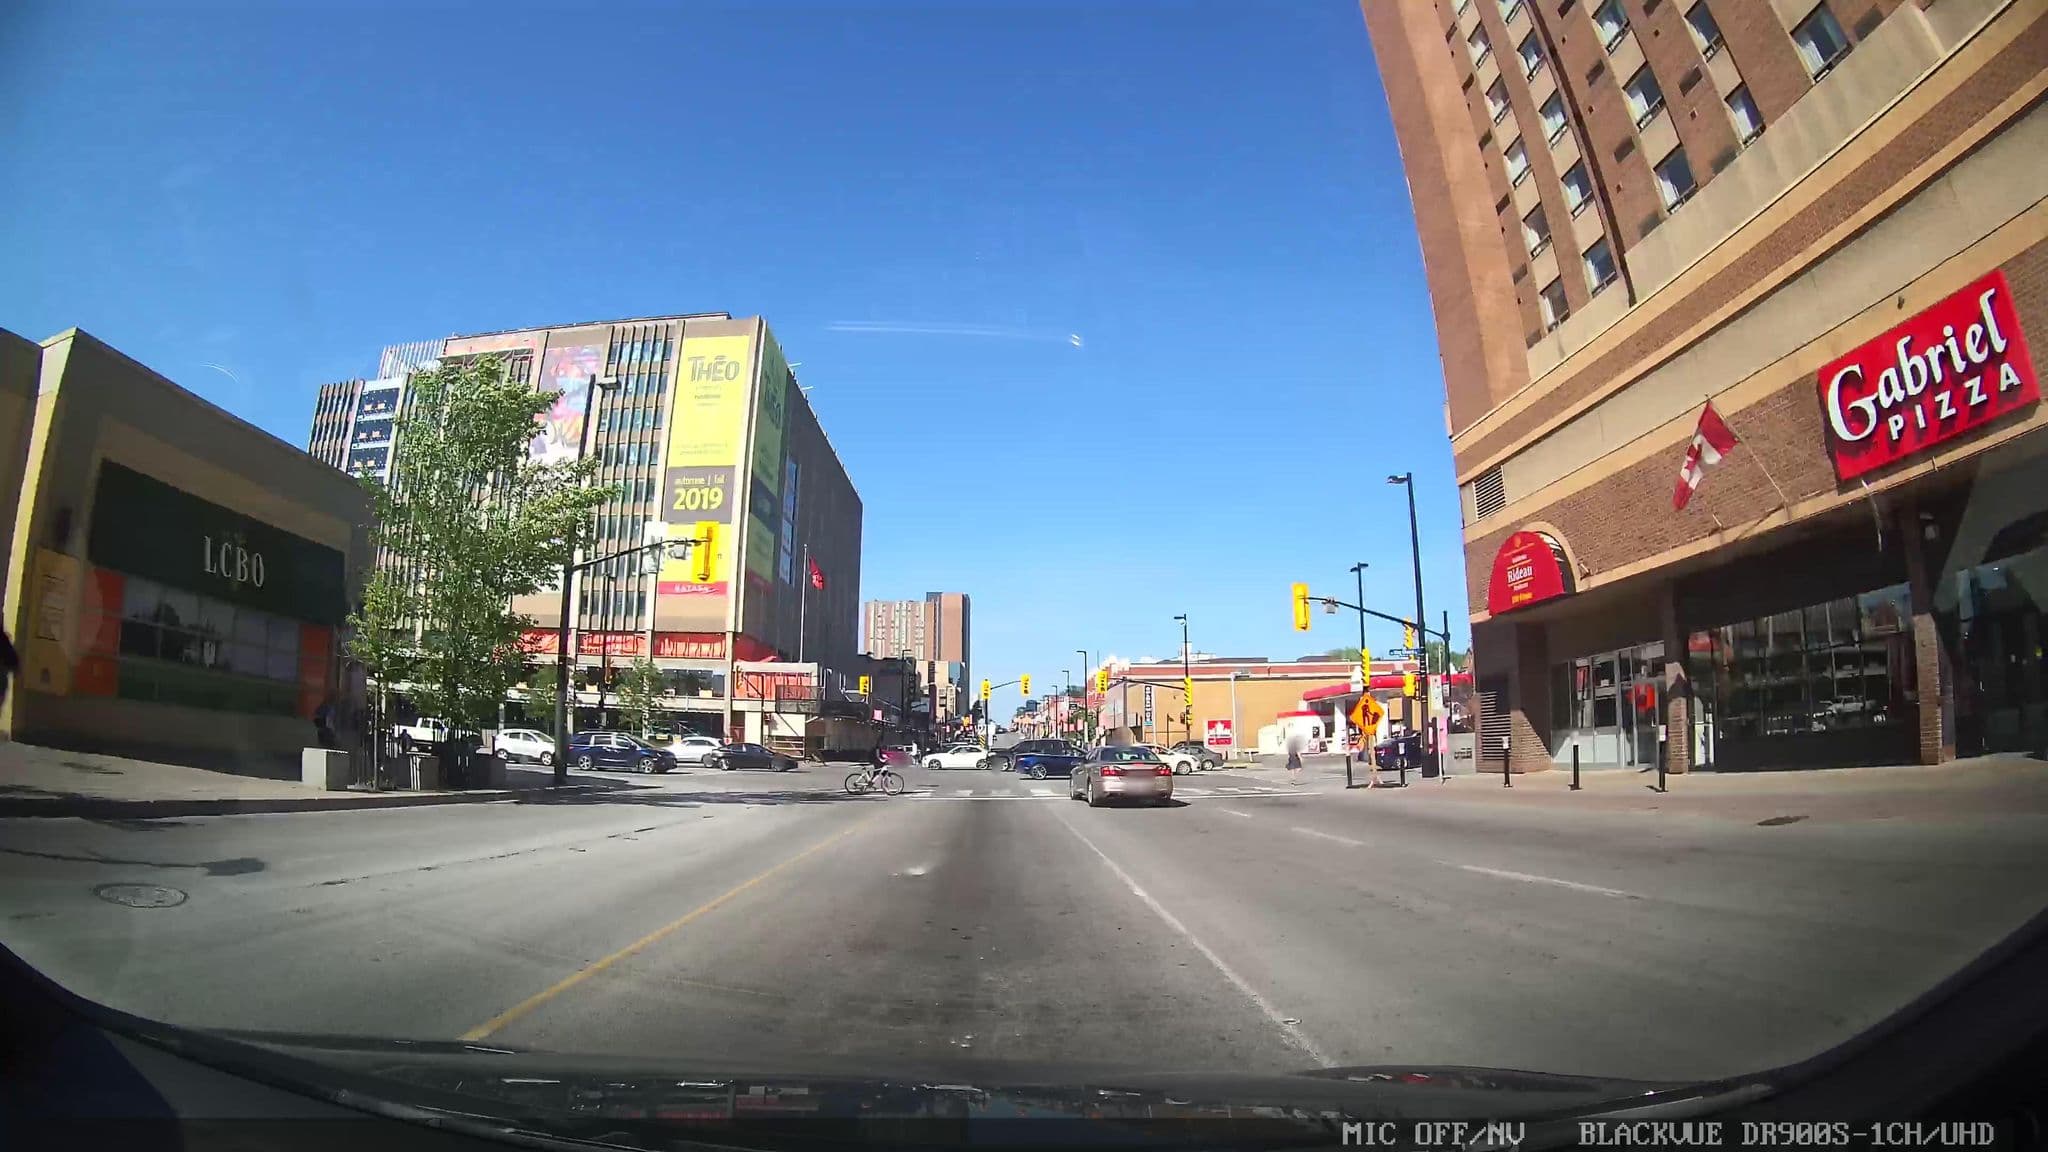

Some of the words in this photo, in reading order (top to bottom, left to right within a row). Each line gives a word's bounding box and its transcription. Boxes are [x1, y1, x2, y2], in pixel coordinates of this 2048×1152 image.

[1828, 288, 2006, 442] Gabriel
[1888, 363, 2021, 440] PIZZA
[673, 487, 723, 510] 2019
[204, 535, 265, 587] LCBO
[1507, 566, 1533, 583] Rideau
